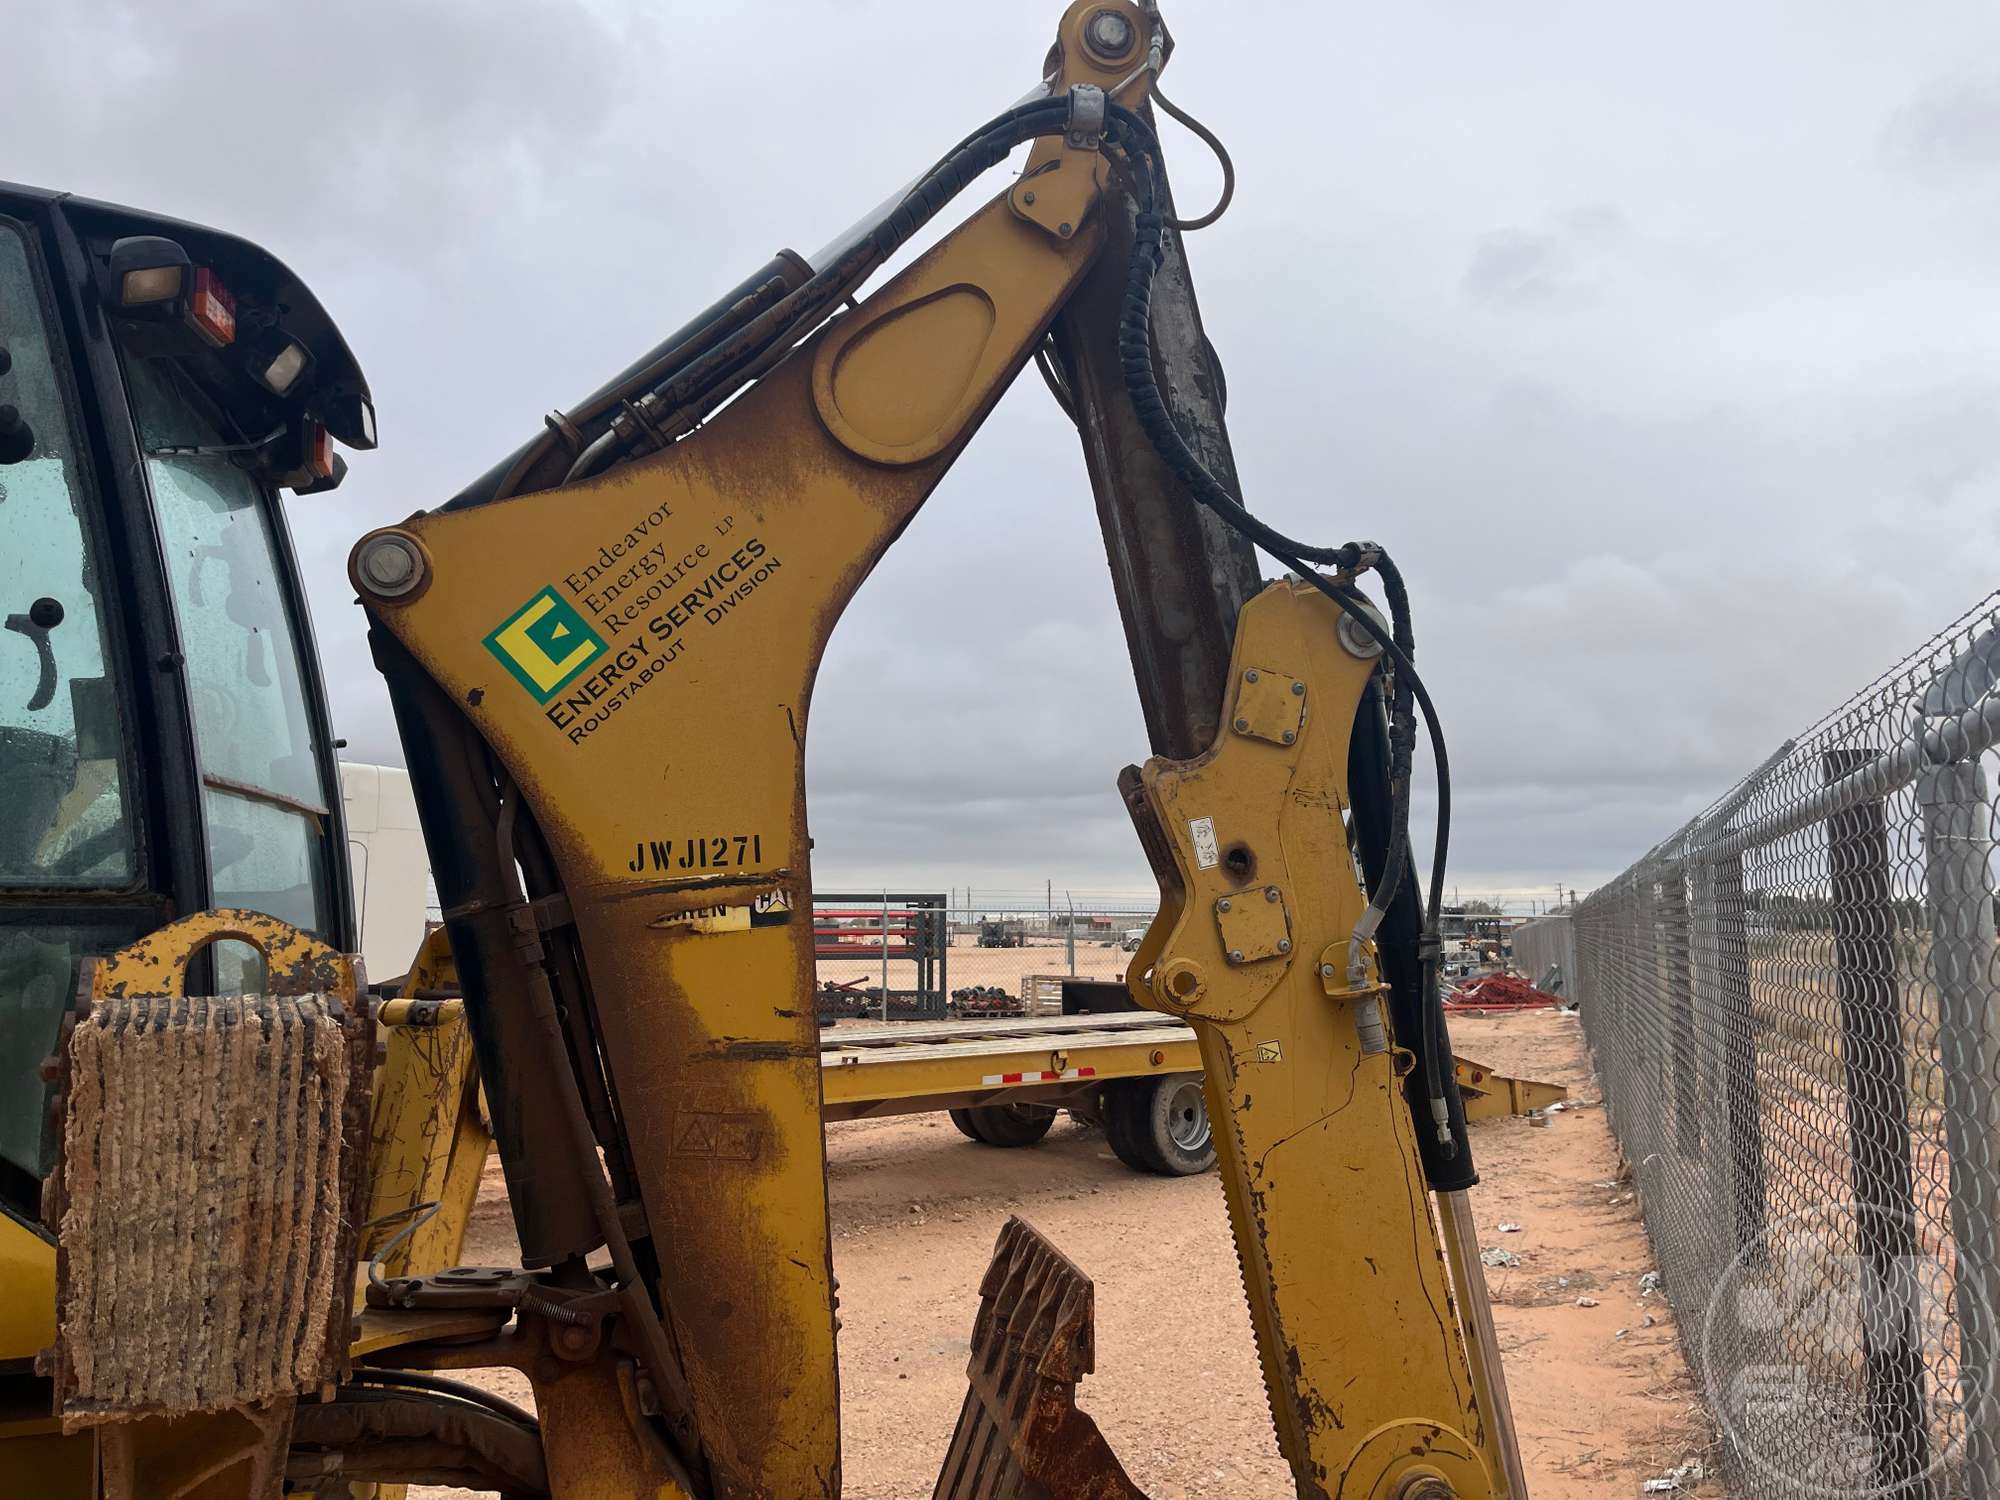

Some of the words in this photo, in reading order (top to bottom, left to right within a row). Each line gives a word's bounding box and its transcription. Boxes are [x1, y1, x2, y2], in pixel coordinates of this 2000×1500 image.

[563, 501, 673, 595] Endeavor
[582, 542, 667, 616] Energy
[601, 543, 710, 635] Resource
[715, 515, 736, 536] LP
[545, 636, 650, 730] ENERGY
[649, 538, 766, 641] SERVICES
[567, 638, 686, 745] ROUSTABOUT
[704, 557, 781, 625] DIVISION
